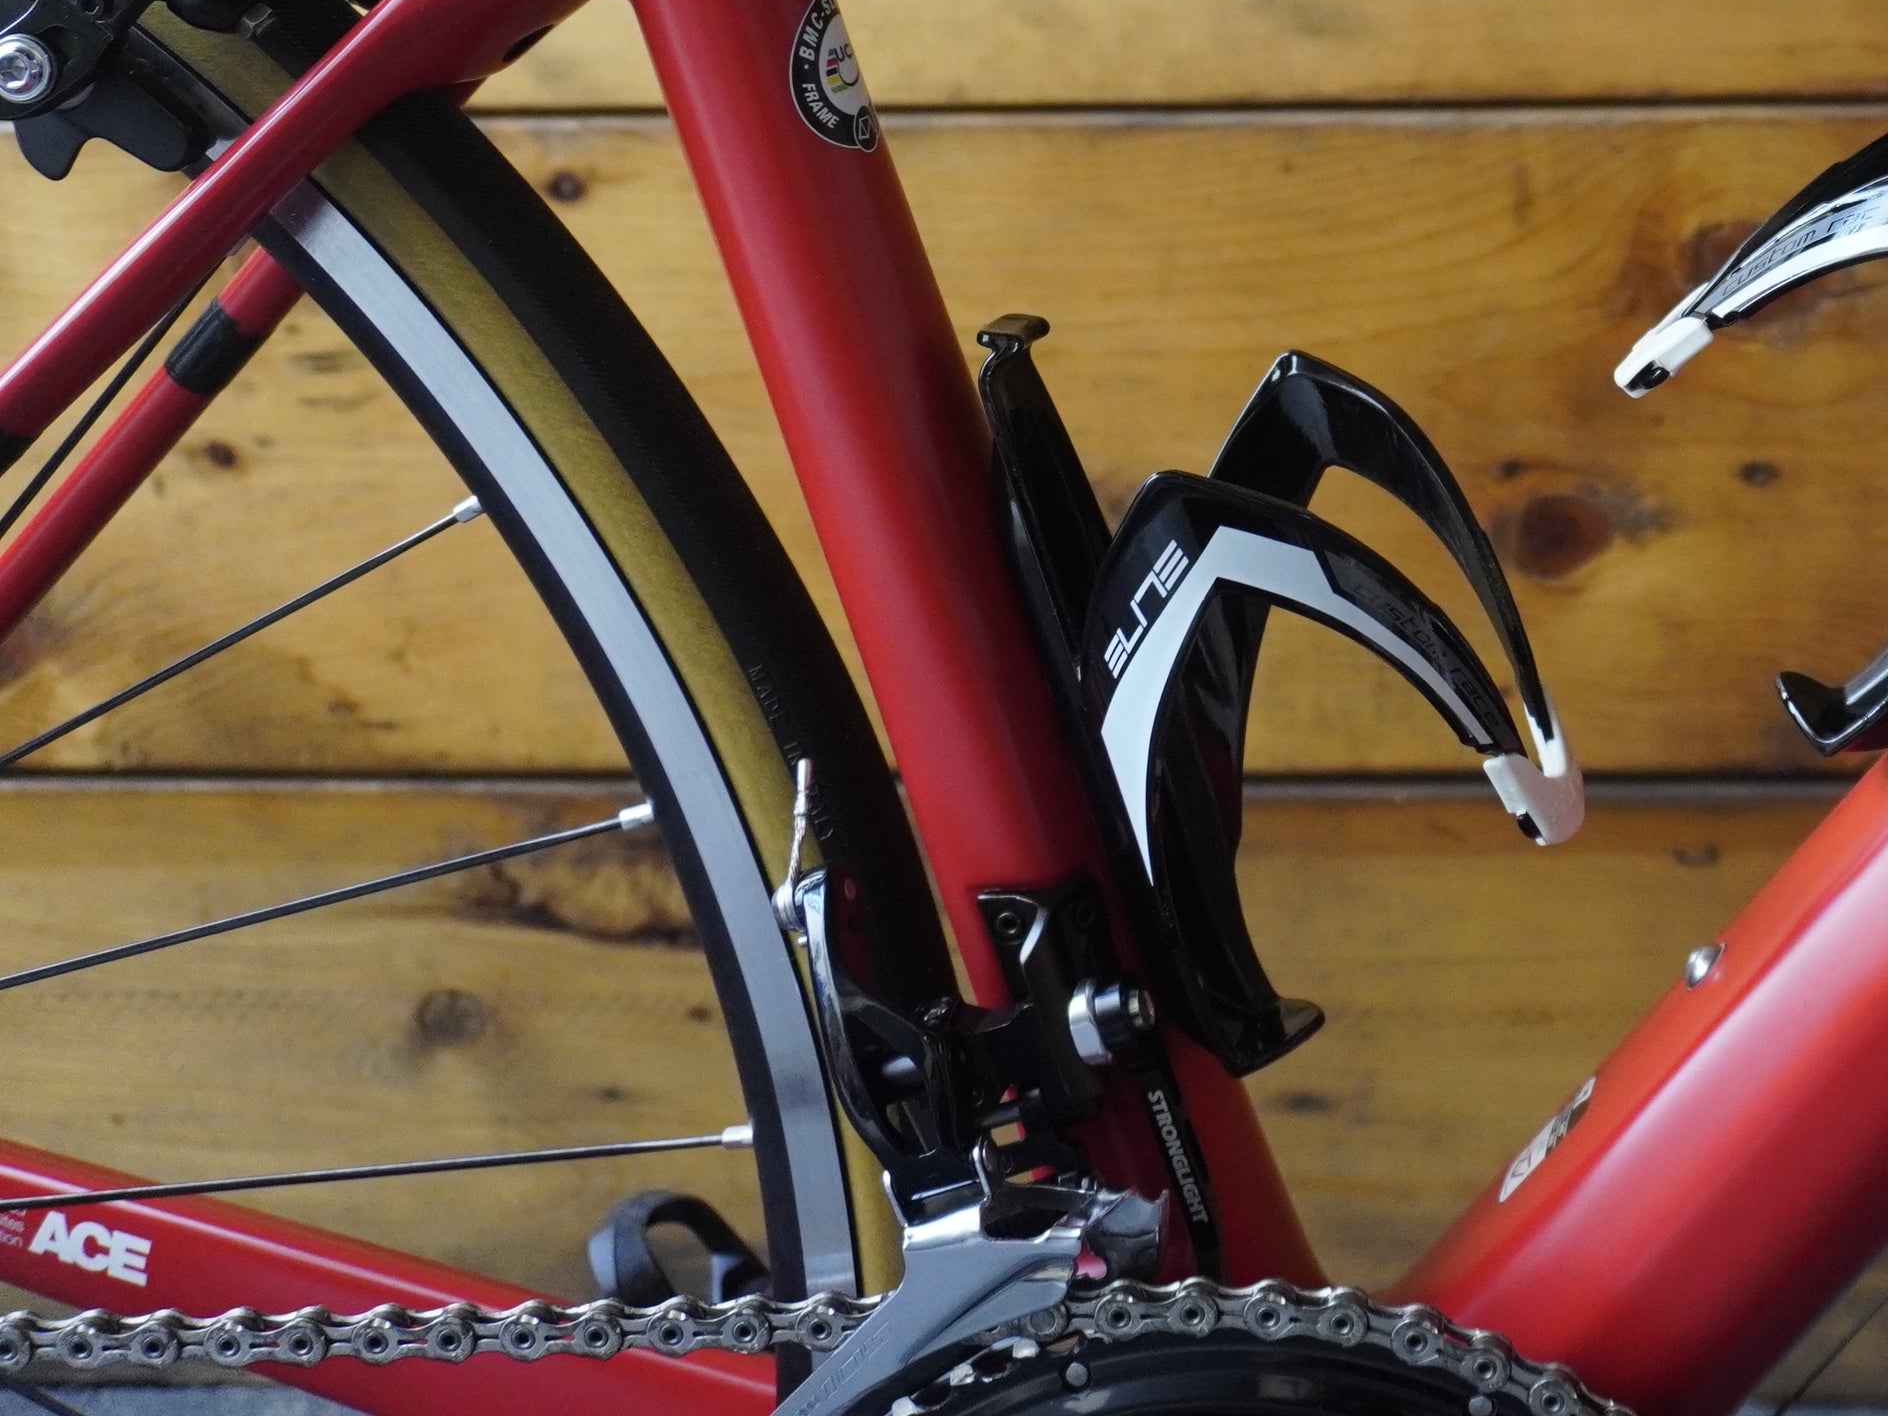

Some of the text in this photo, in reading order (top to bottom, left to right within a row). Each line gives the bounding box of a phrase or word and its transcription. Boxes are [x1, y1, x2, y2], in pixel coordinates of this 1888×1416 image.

[802, 82, 840, 129] FRAME
[1146, 1088, 1209, 1224] STRONGLIGHT
[28, 1210, 152, 1287] ACE
